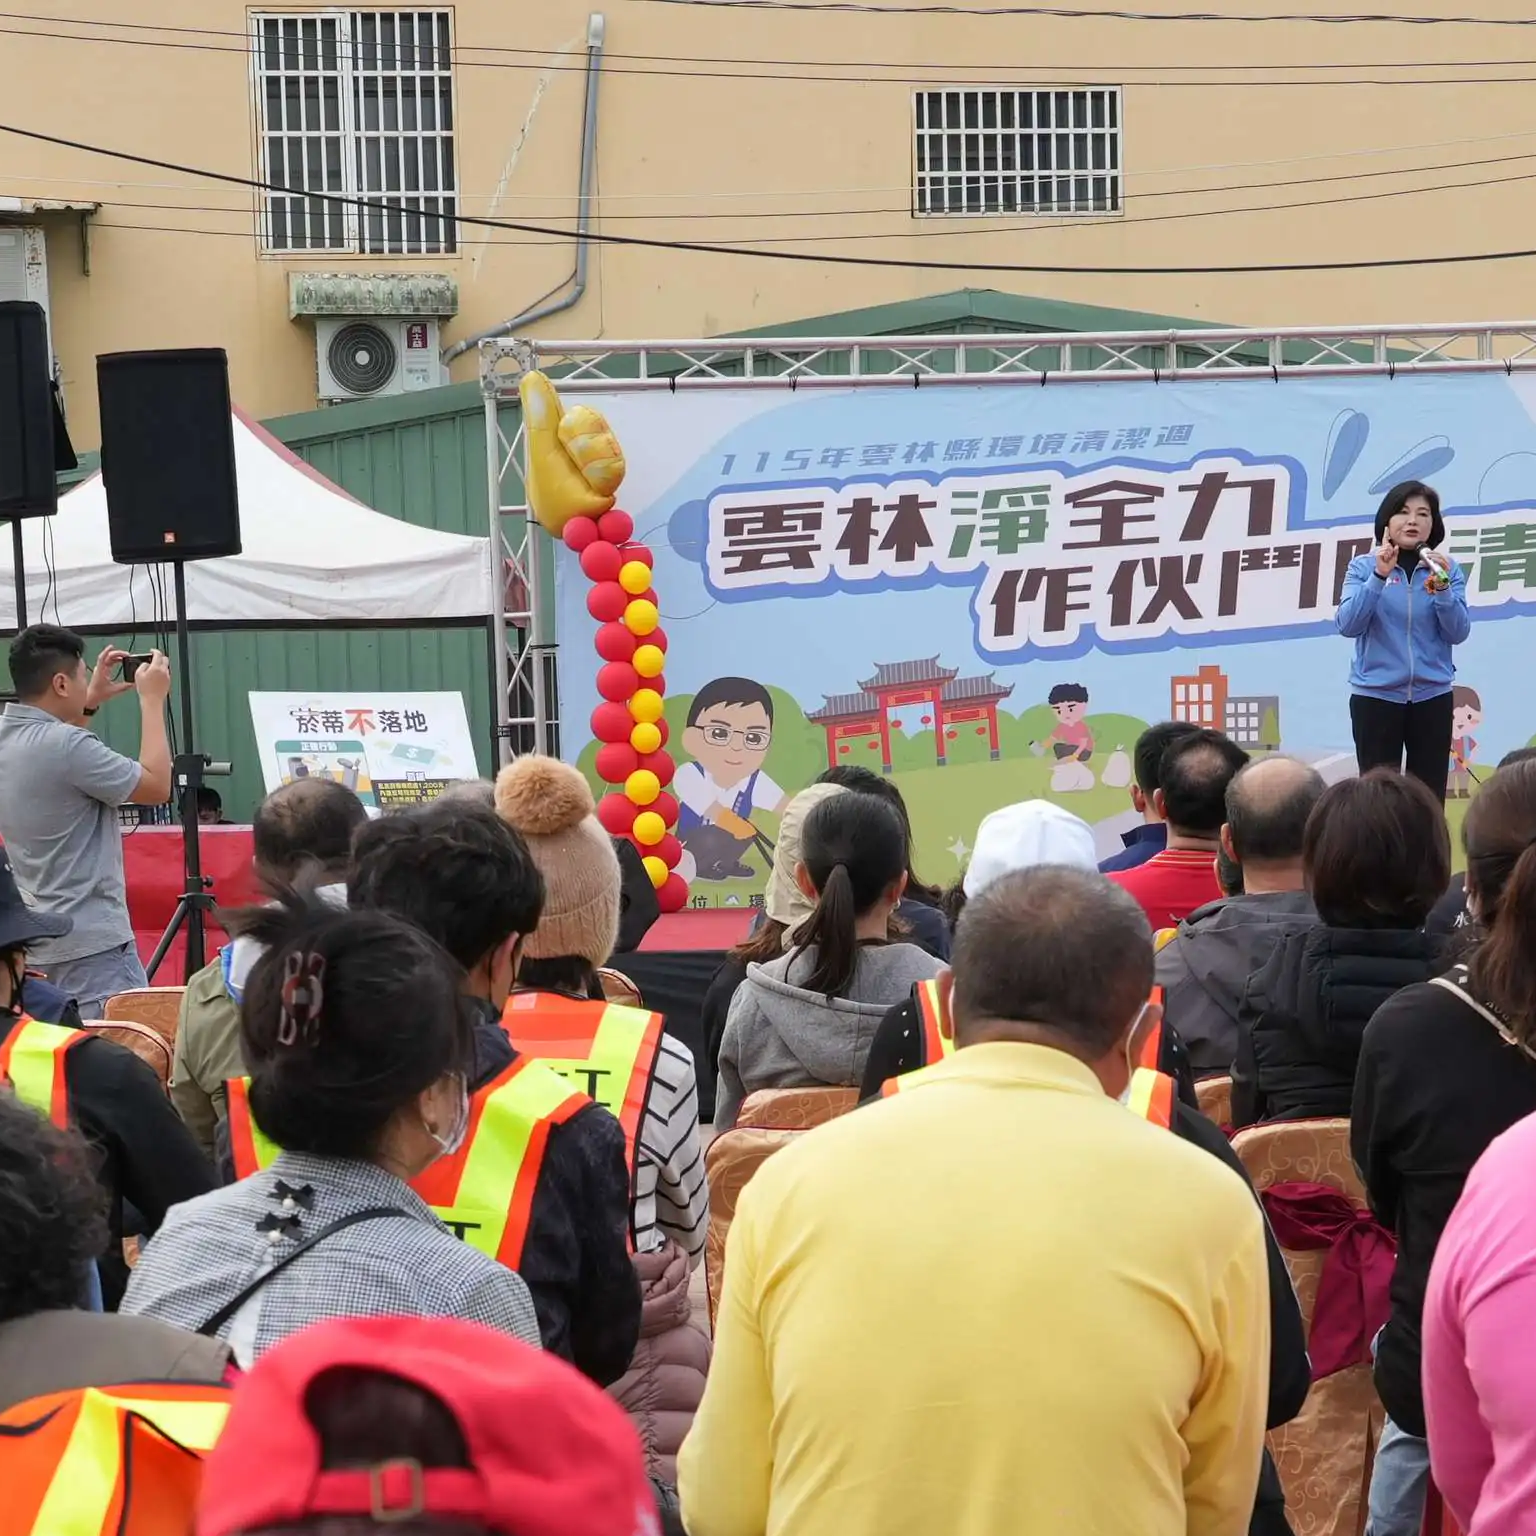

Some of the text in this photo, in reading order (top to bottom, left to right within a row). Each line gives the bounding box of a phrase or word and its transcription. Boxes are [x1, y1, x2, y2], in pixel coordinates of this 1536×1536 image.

[720, 423, 1196, 476] 115年雲林縣環境清潔週
[723, 471, 1275, 575] 雲林淨全力
[294, 707, 429, 736] 菸蒂不落地
